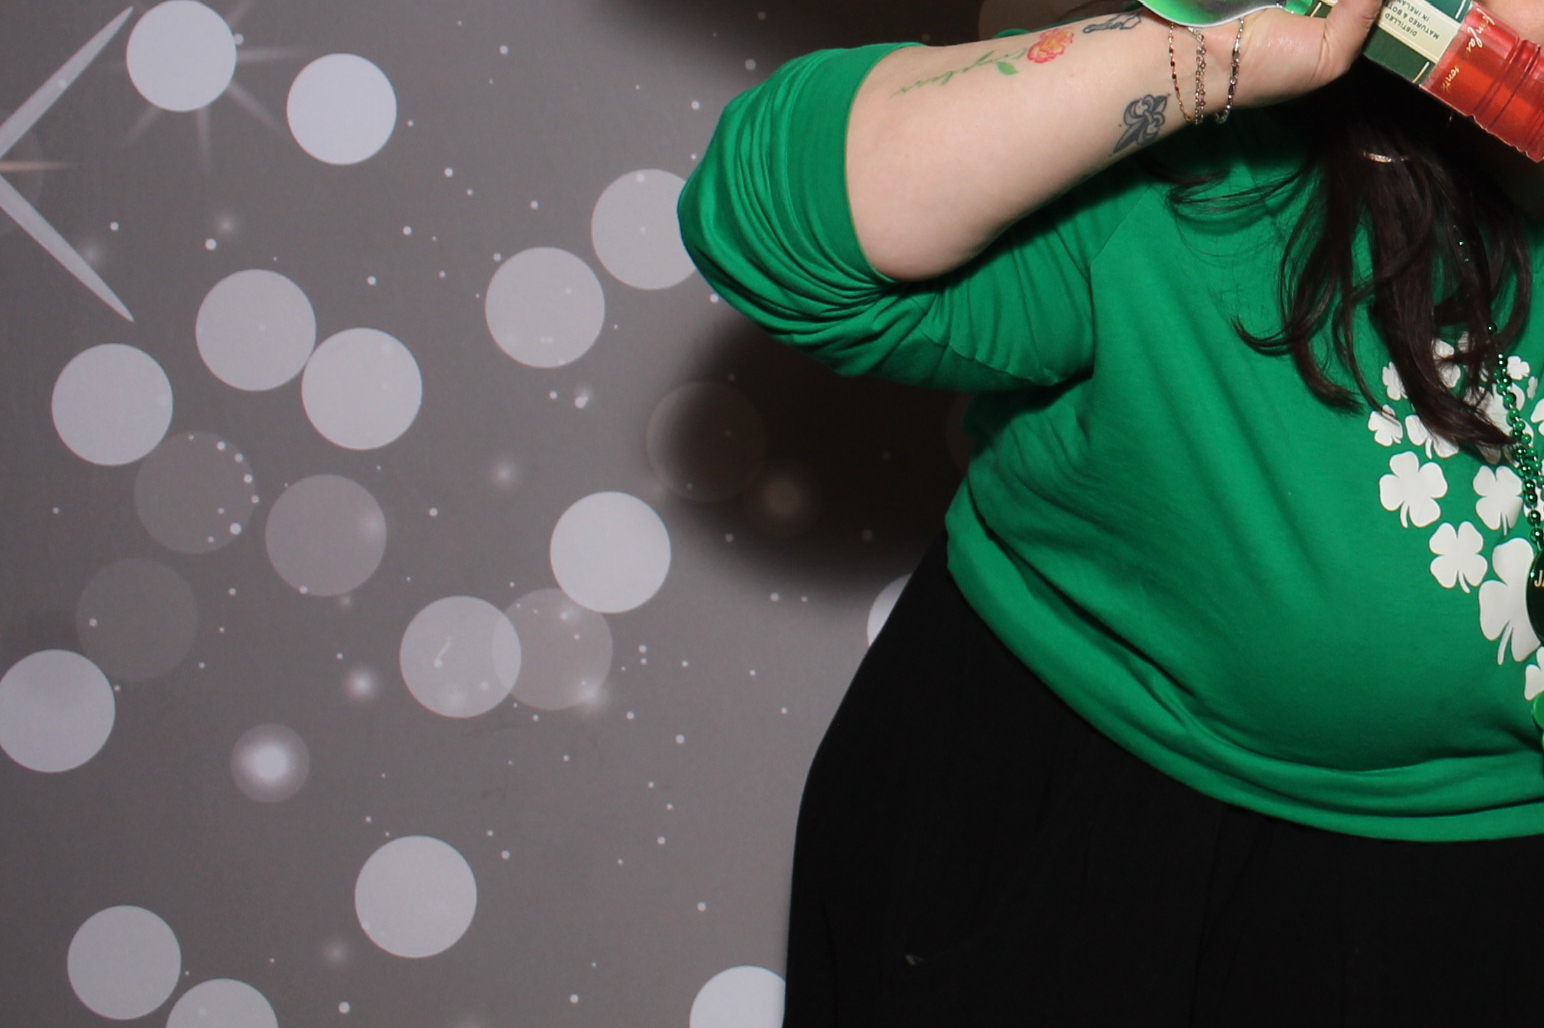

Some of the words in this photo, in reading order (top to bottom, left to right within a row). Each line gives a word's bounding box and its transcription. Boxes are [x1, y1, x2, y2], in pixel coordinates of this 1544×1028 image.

[1383, 12, 1418, 36] DISTILLED
[1406, 16, 1440, 39] MATURED
[1421, 13, 1430, 21] IN
